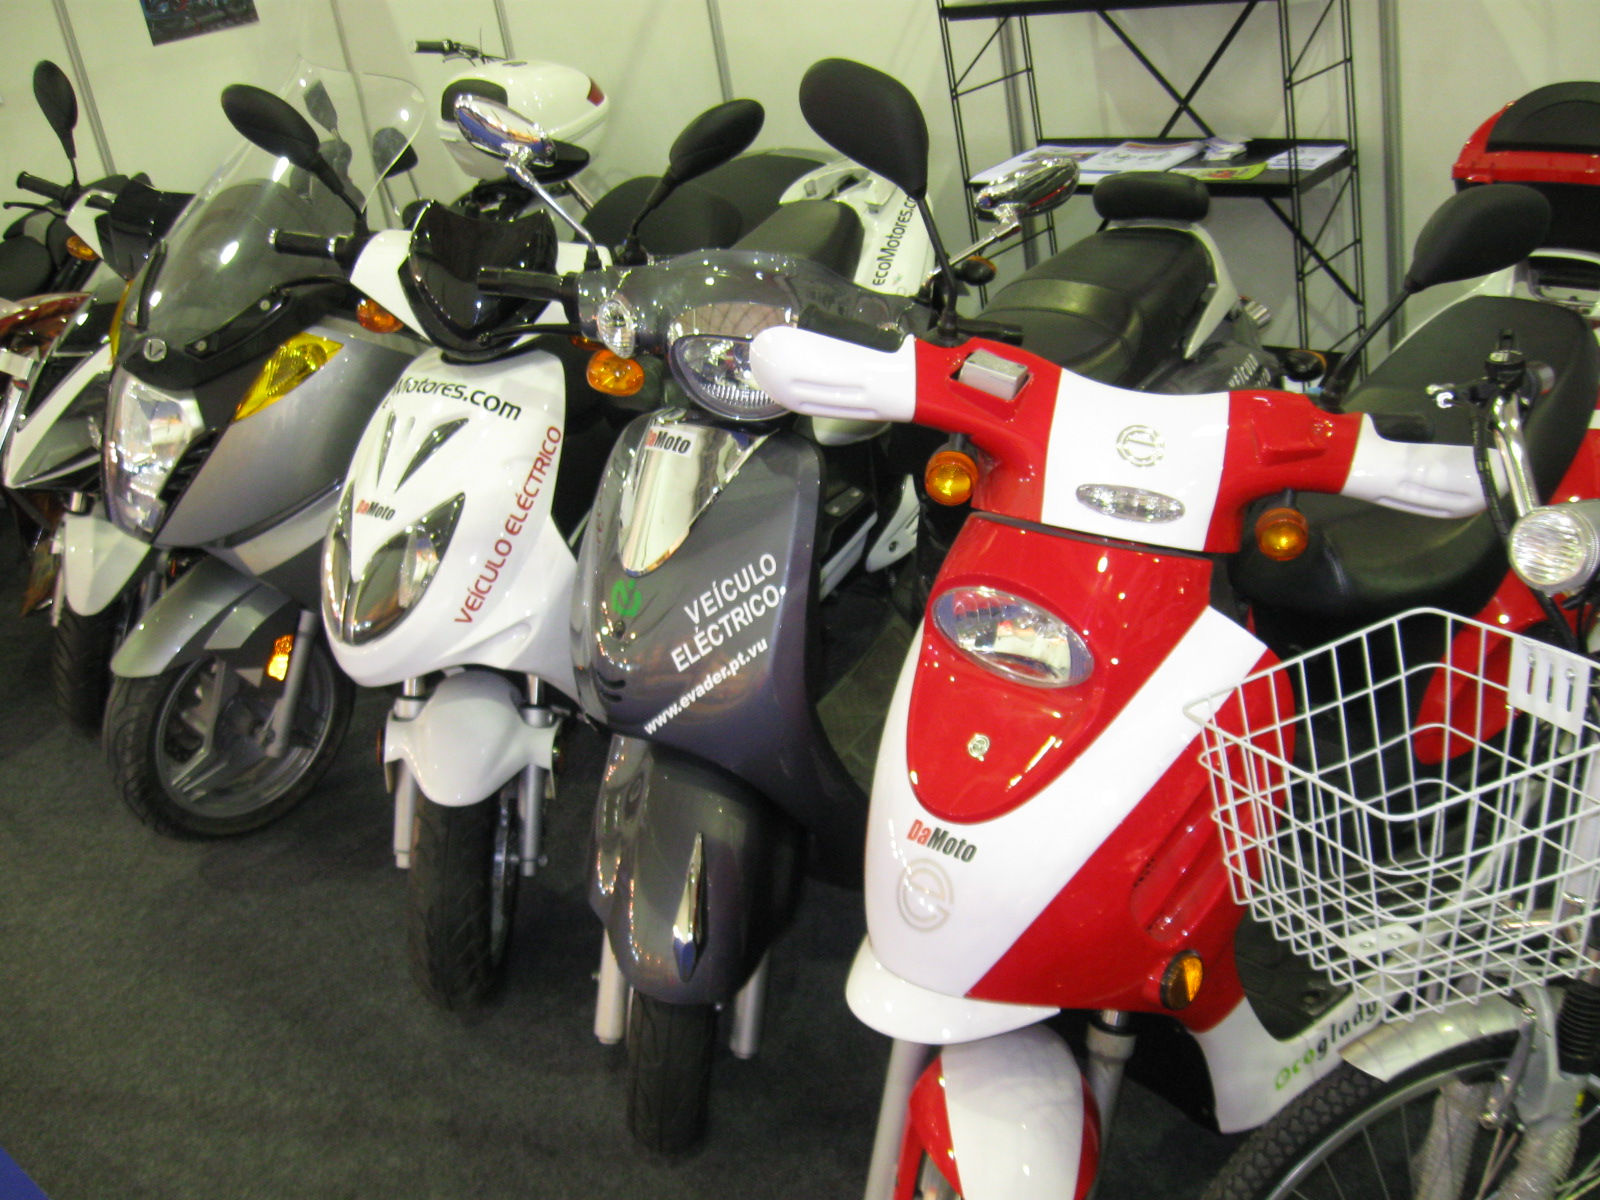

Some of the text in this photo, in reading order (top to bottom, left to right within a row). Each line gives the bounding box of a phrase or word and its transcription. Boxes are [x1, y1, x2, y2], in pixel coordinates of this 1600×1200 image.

[383, 377, 522, 421] Motores.com
[454, 426, 562, 624] VEÍCULO ELÉCTRICO
[670, 585, 780, 673] ELÉCTRICO
[684, 553, 777, 625] VEÍCULO
[643, 637, 769, 735] www.evader.pt.vu
[906, 819, 978, 863] DaMoto
